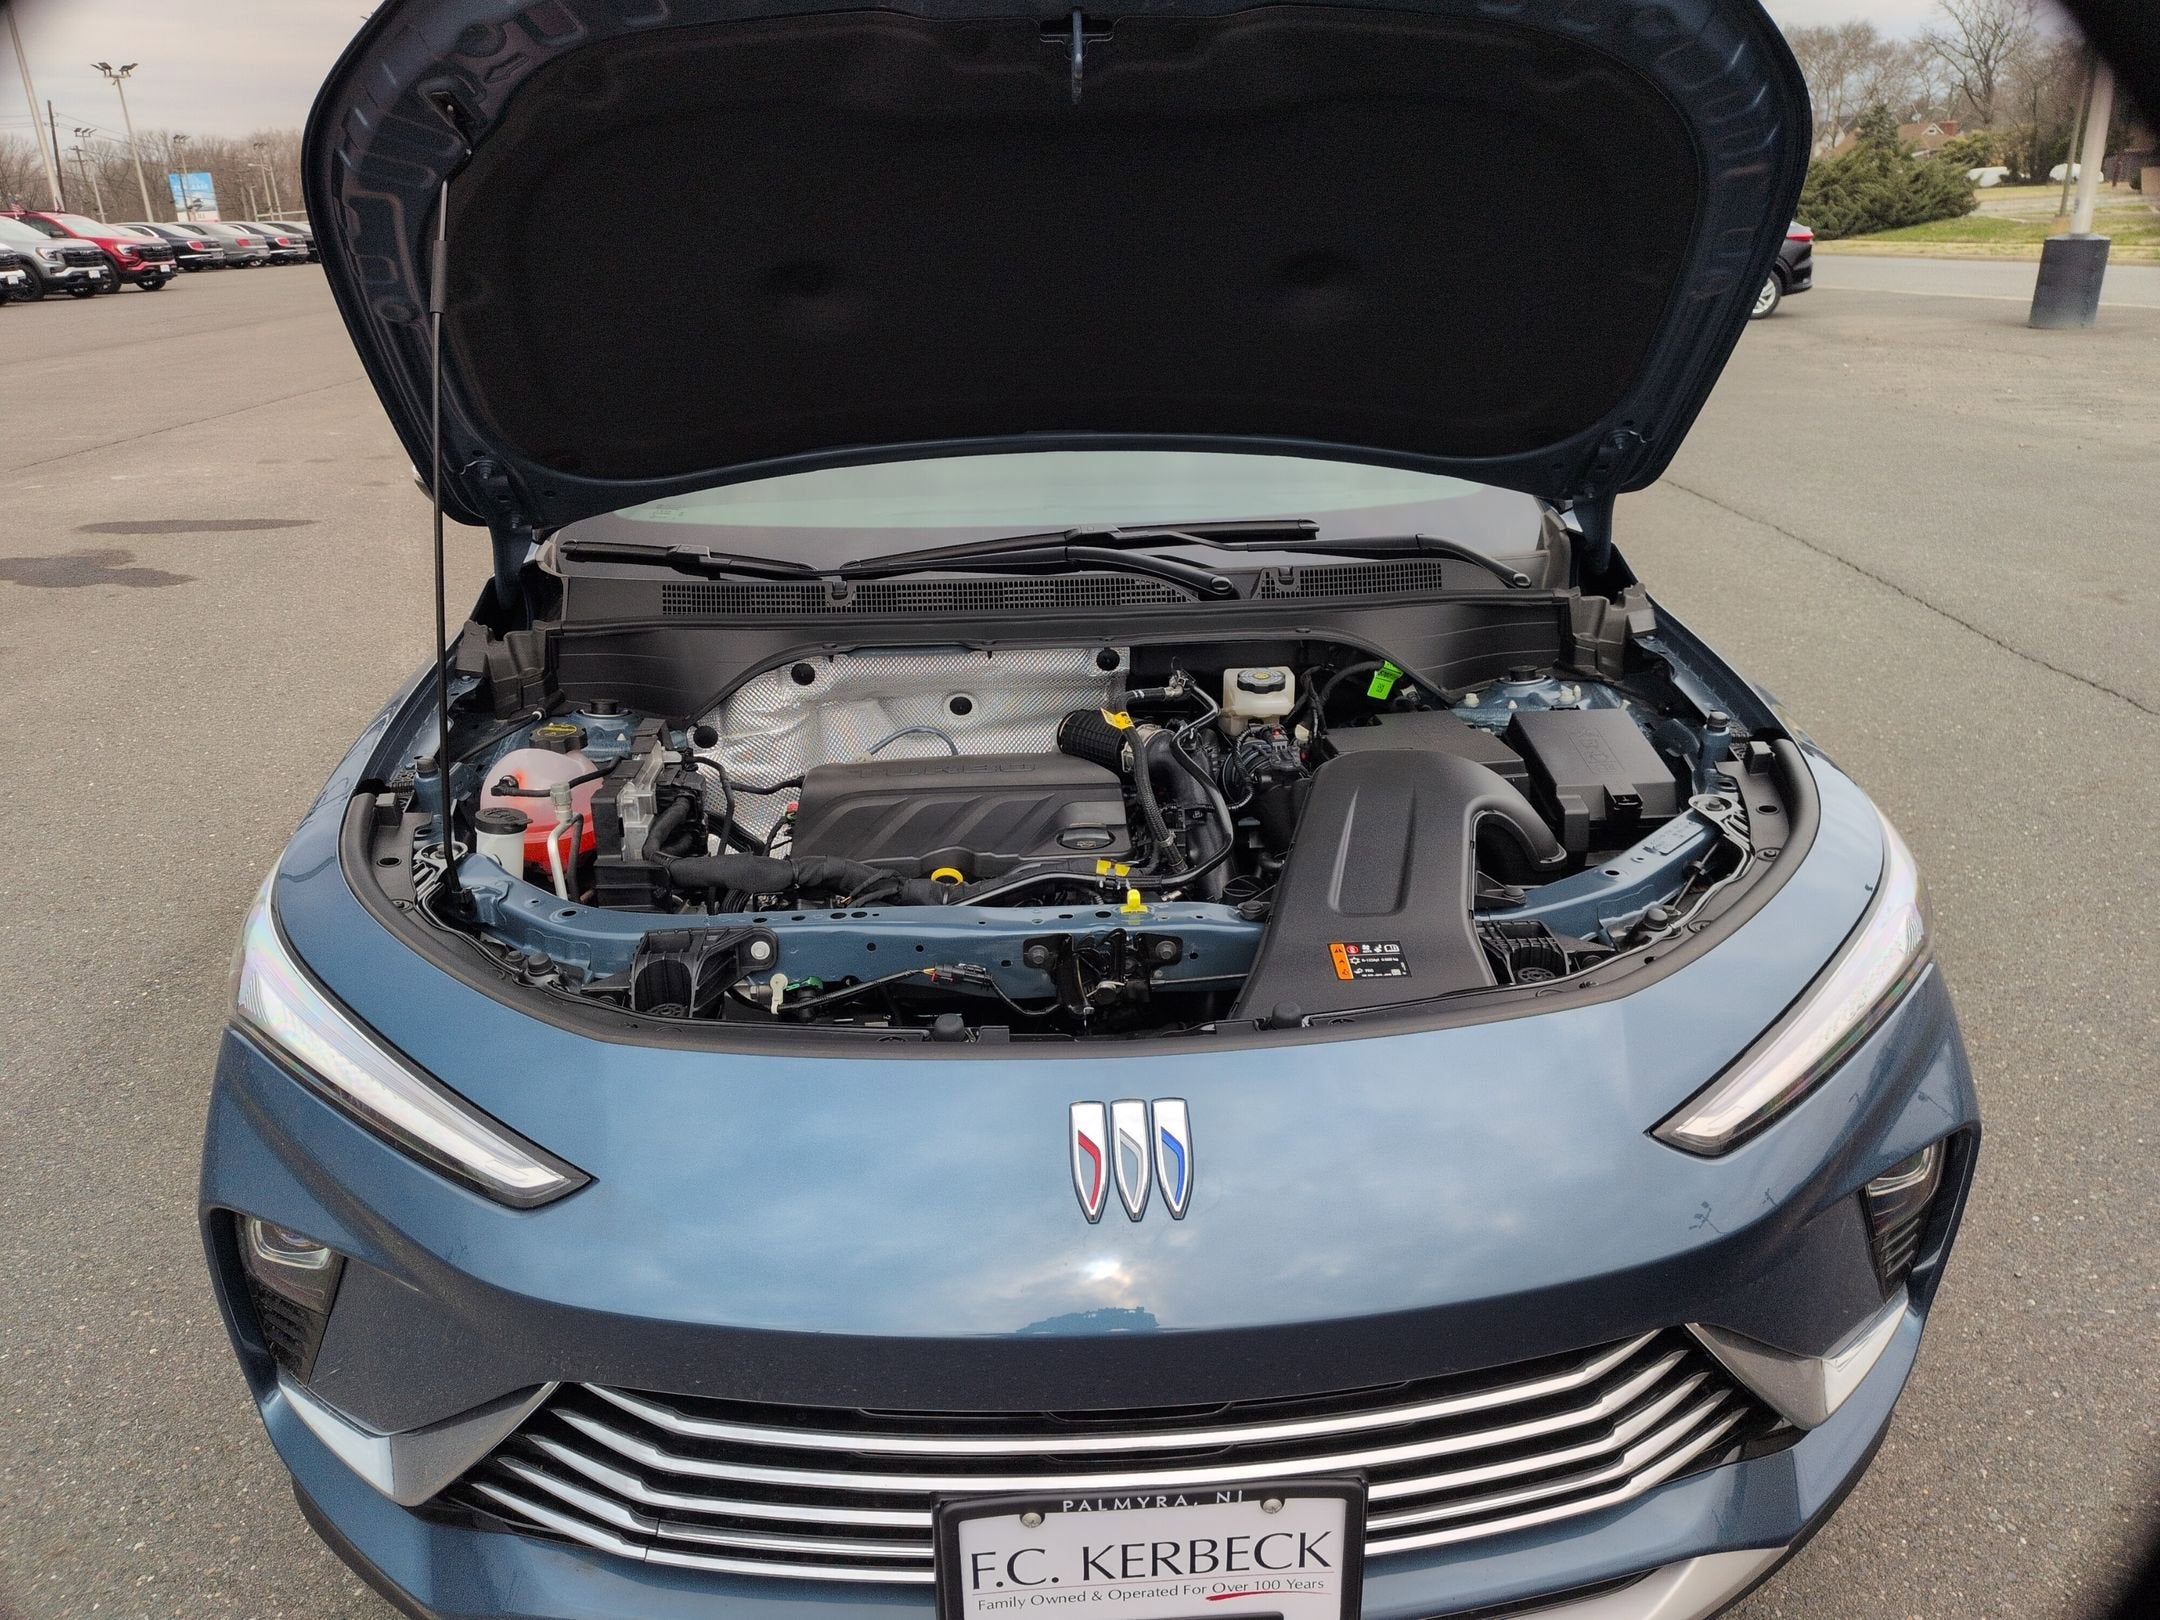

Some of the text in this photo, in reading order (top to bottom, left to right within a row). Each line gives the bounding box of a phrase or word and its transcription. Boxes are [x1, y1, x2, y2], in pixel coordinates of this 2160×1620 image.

[1062, 1495, 1199, 1513] PALMYRA,
[971, 1530, 1333, 1590] F.C. KERBECK
[978, 1578, 1325, 1611] Family Owned & Operated For Over 100 Years
